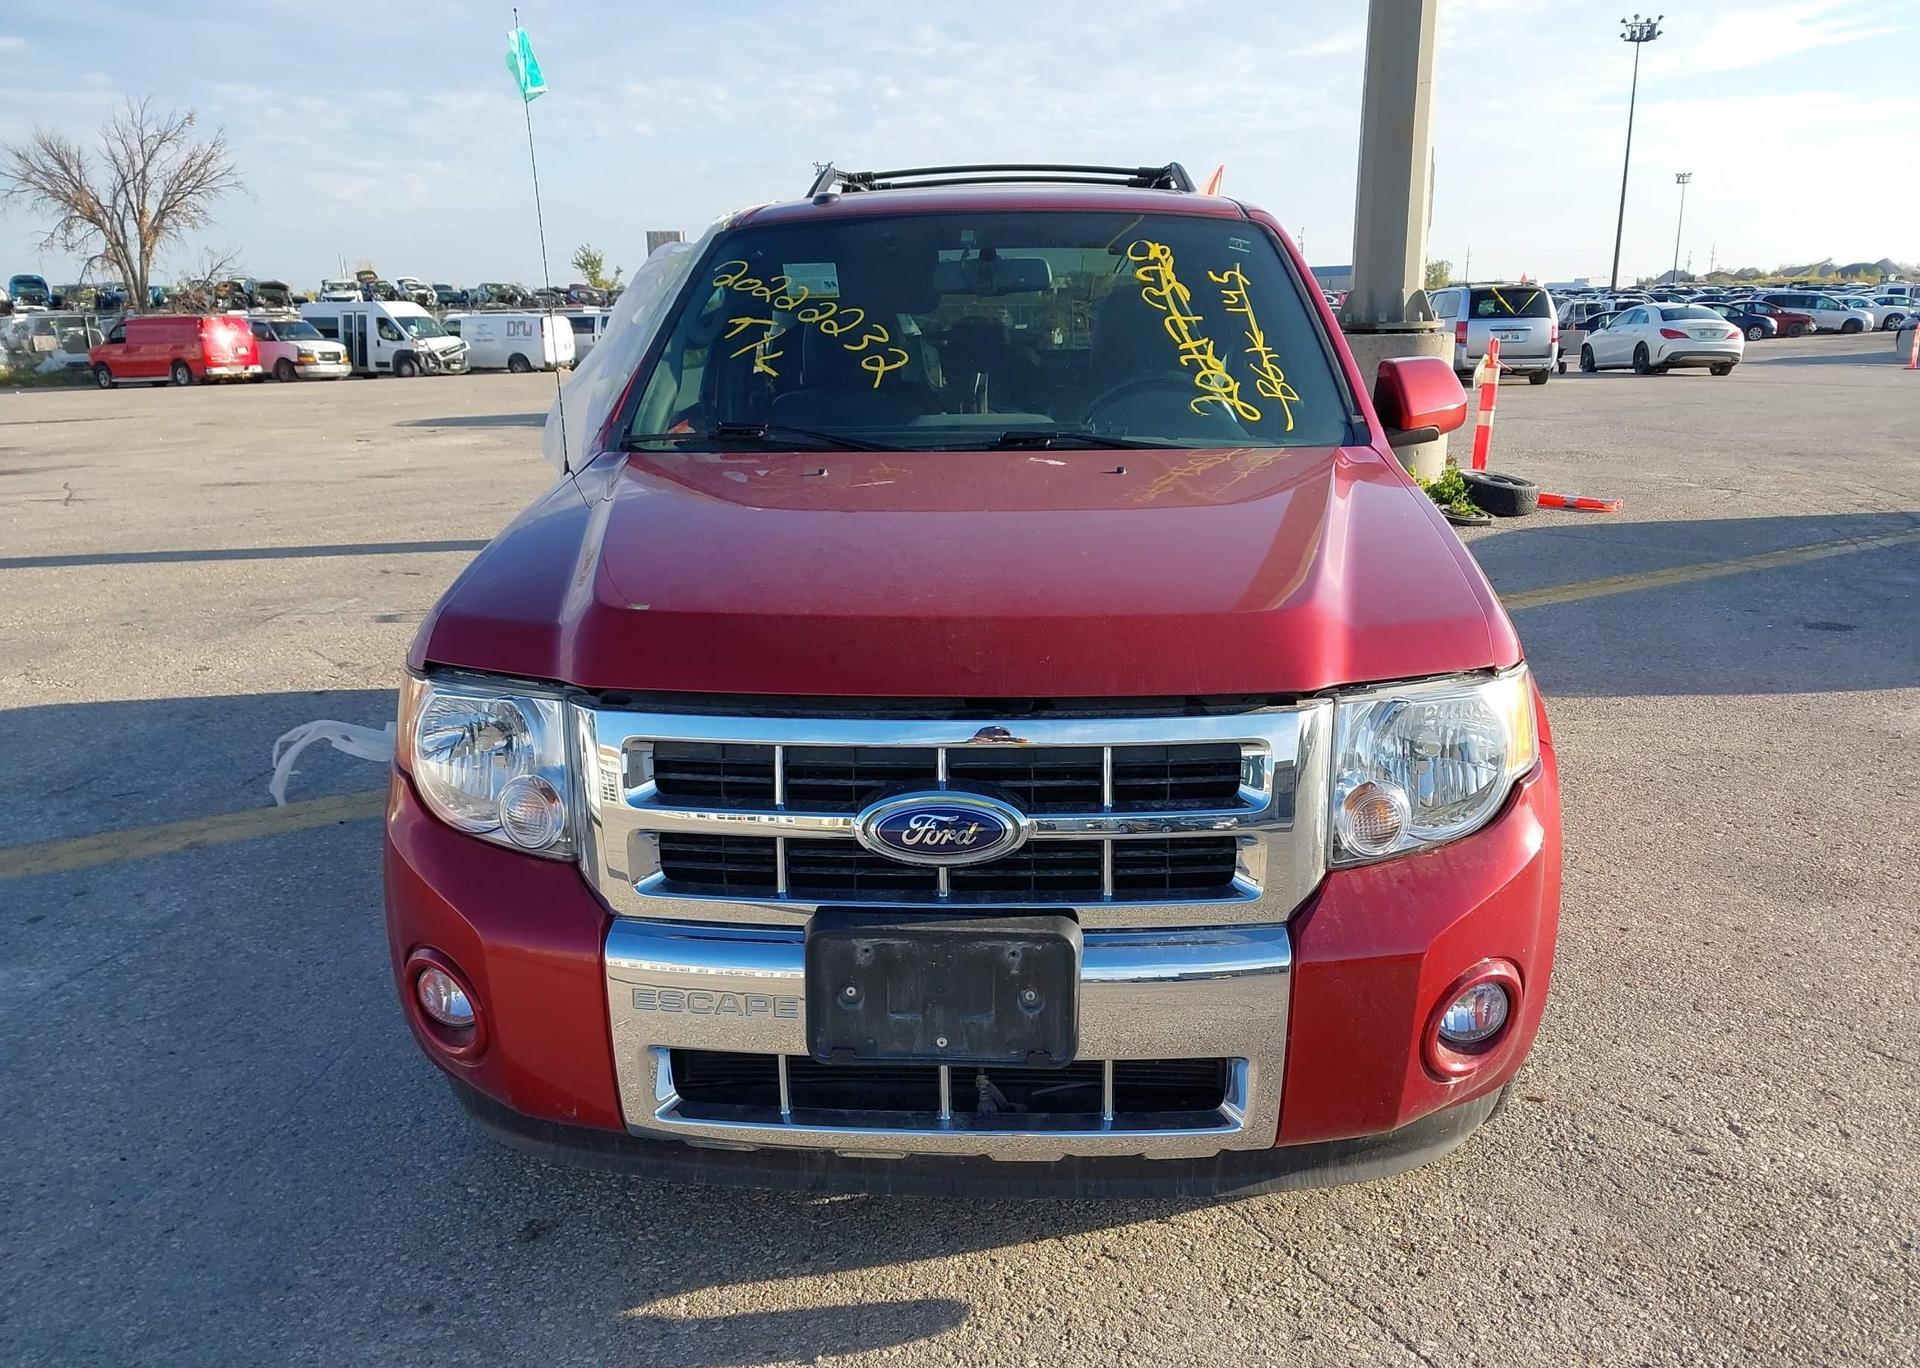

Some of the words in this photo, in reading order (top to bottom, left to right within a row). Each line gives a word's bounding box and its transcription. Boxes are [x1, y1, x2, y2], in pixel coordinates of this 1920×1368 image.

[713, 261, 909, 388] 20222232
[902, 813, 979, 846] Ford
[632, 988, 799, 1019] ESCAPE
